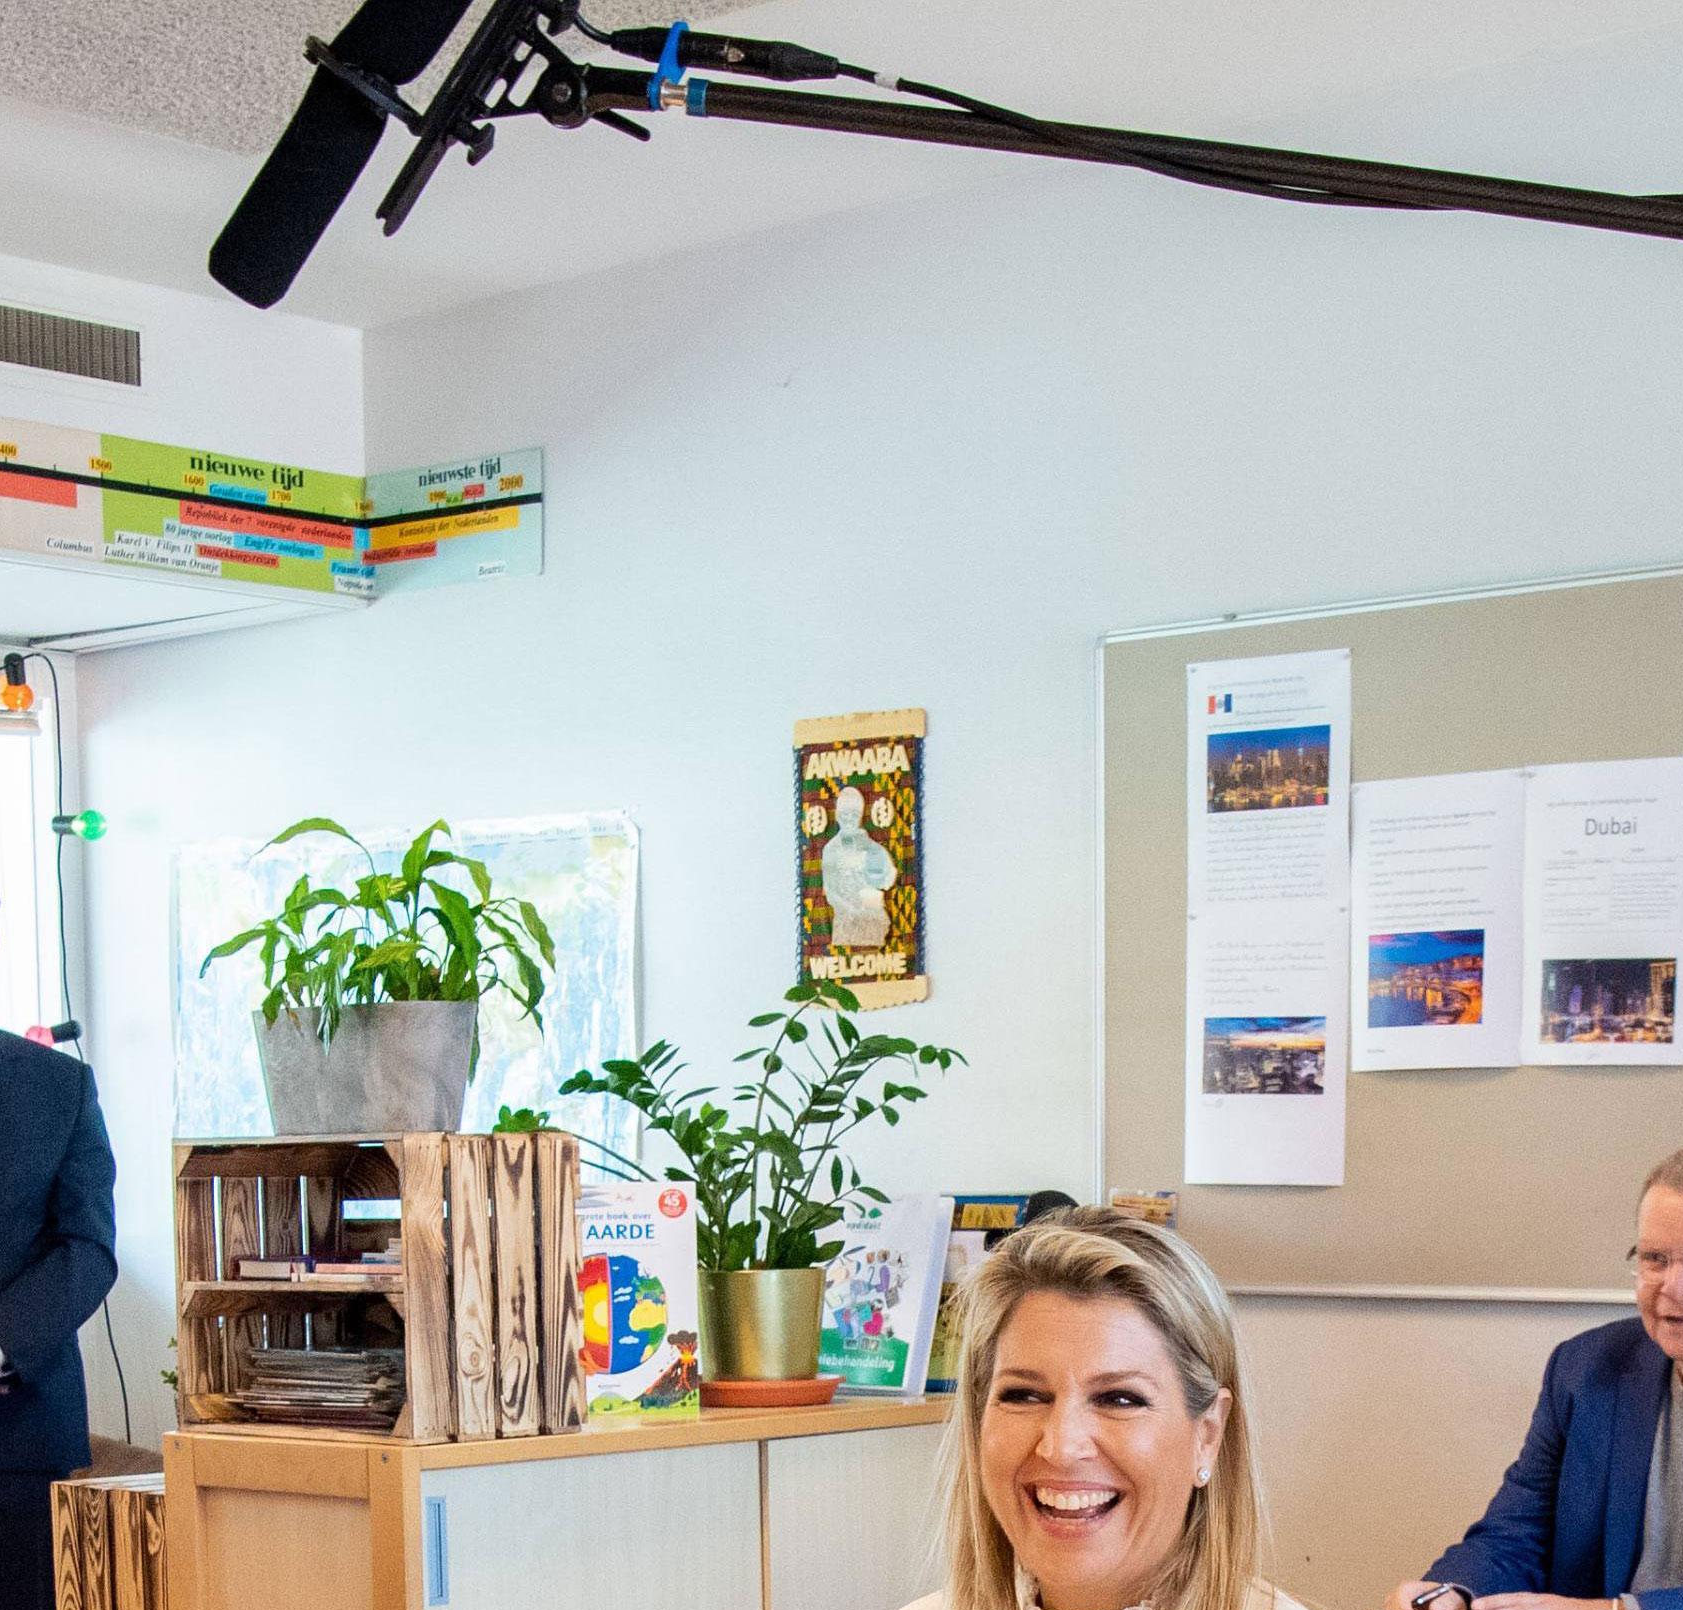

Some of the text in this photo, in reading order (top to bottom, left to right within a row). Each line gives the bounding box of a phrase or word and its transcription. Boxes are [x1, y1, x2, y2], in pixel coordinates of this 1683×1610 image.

[89, 457, 112, 472] 1500
[189, 454, 304, 490] nieuwe tijd
[418, 457, 502, 488] nieuwste tijd
[183, 473, 205, 487] 1600
[498, 475, 524, 492] 2000
[270, 489, 292, 503] 1700
[45, 536, 94, 555] Columbus
[116, 532, 192, 555] Karel V Filips II
[104, 546, 219, 575] Luther Willem van Oranje
[805, 744, 911, 781] AKWAABA
[1584, 816, 1638, 836] Dubai
[809, 951, 908, 980] WELCOME
[586, 1223, 656, 1240] AARDE
